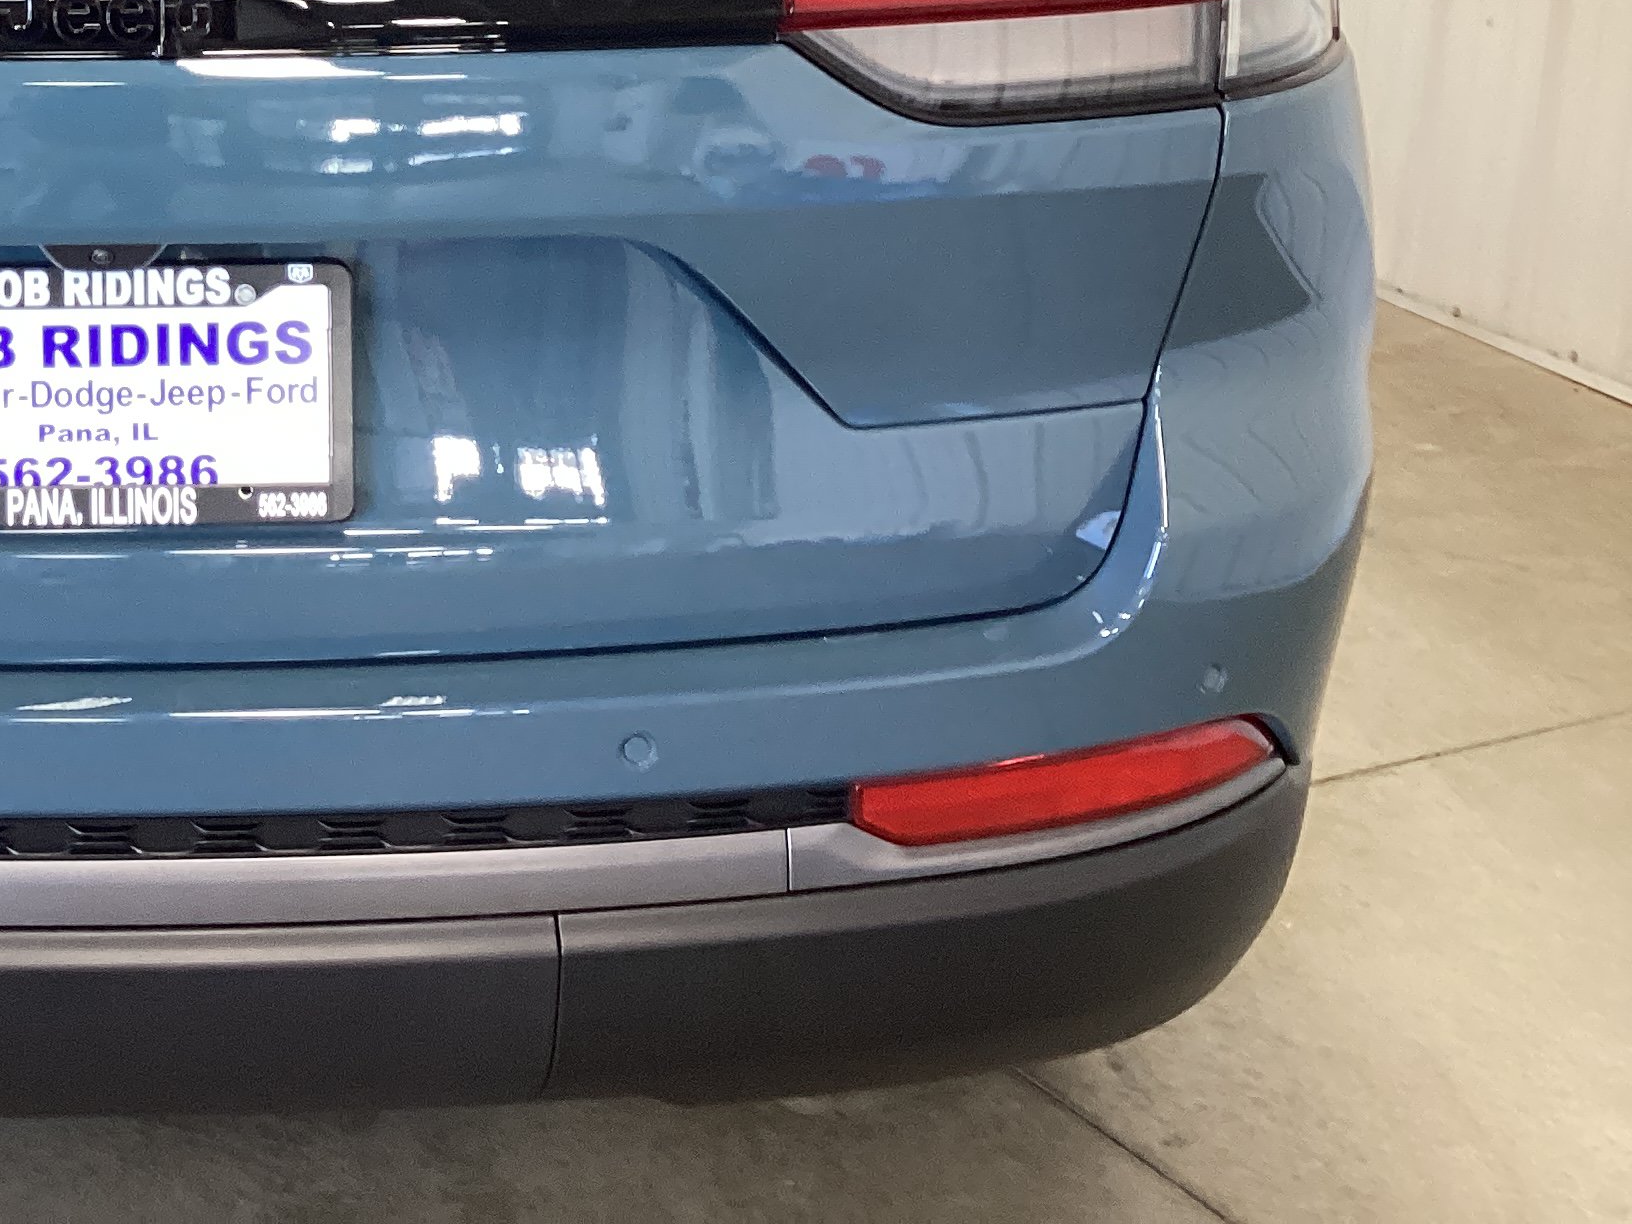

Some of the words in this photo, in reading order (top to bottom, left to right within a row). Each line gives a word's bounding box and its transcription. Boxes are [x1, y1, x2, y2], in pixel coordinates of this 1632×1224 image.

[63, 268, 231, 307] RIDINGS
[42, 320, 313, 369] RIDINGS
[39, 423, 119, 446] Pana,
[132, 422, 159, 442] IL
[7, 488, 83, 526] PANA,
[91, 487, 198, 525] ILLINOIS
